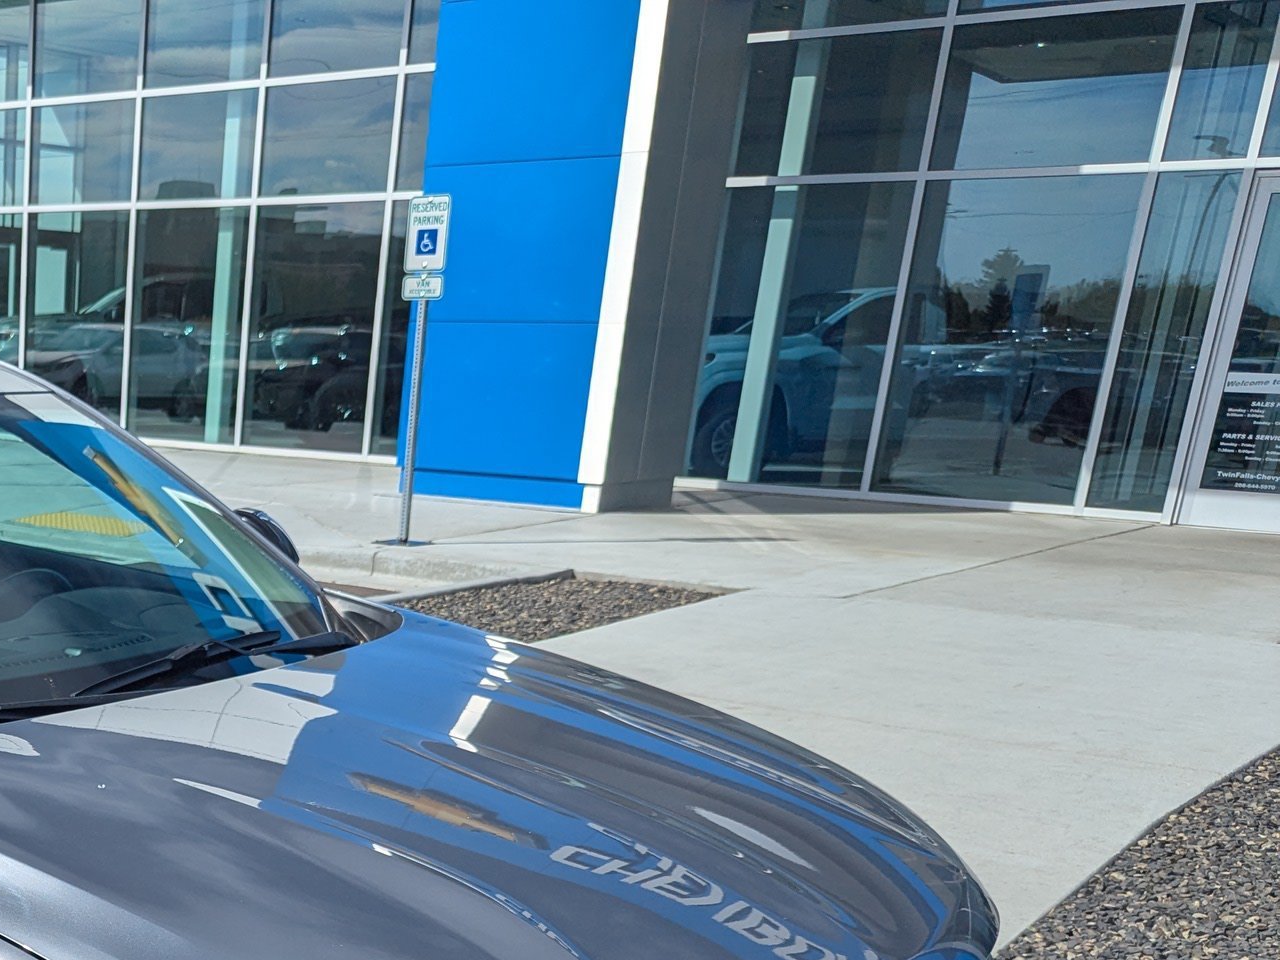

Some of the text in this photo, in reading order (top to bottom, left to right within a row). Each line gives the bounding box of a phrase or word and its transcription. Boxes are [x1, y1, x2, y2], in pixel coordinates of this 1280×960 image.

[412, 202, 447, 213] RESERVED
[413, 215, 444, 226] PARKING
[416, 280, 431, 288] VAN
